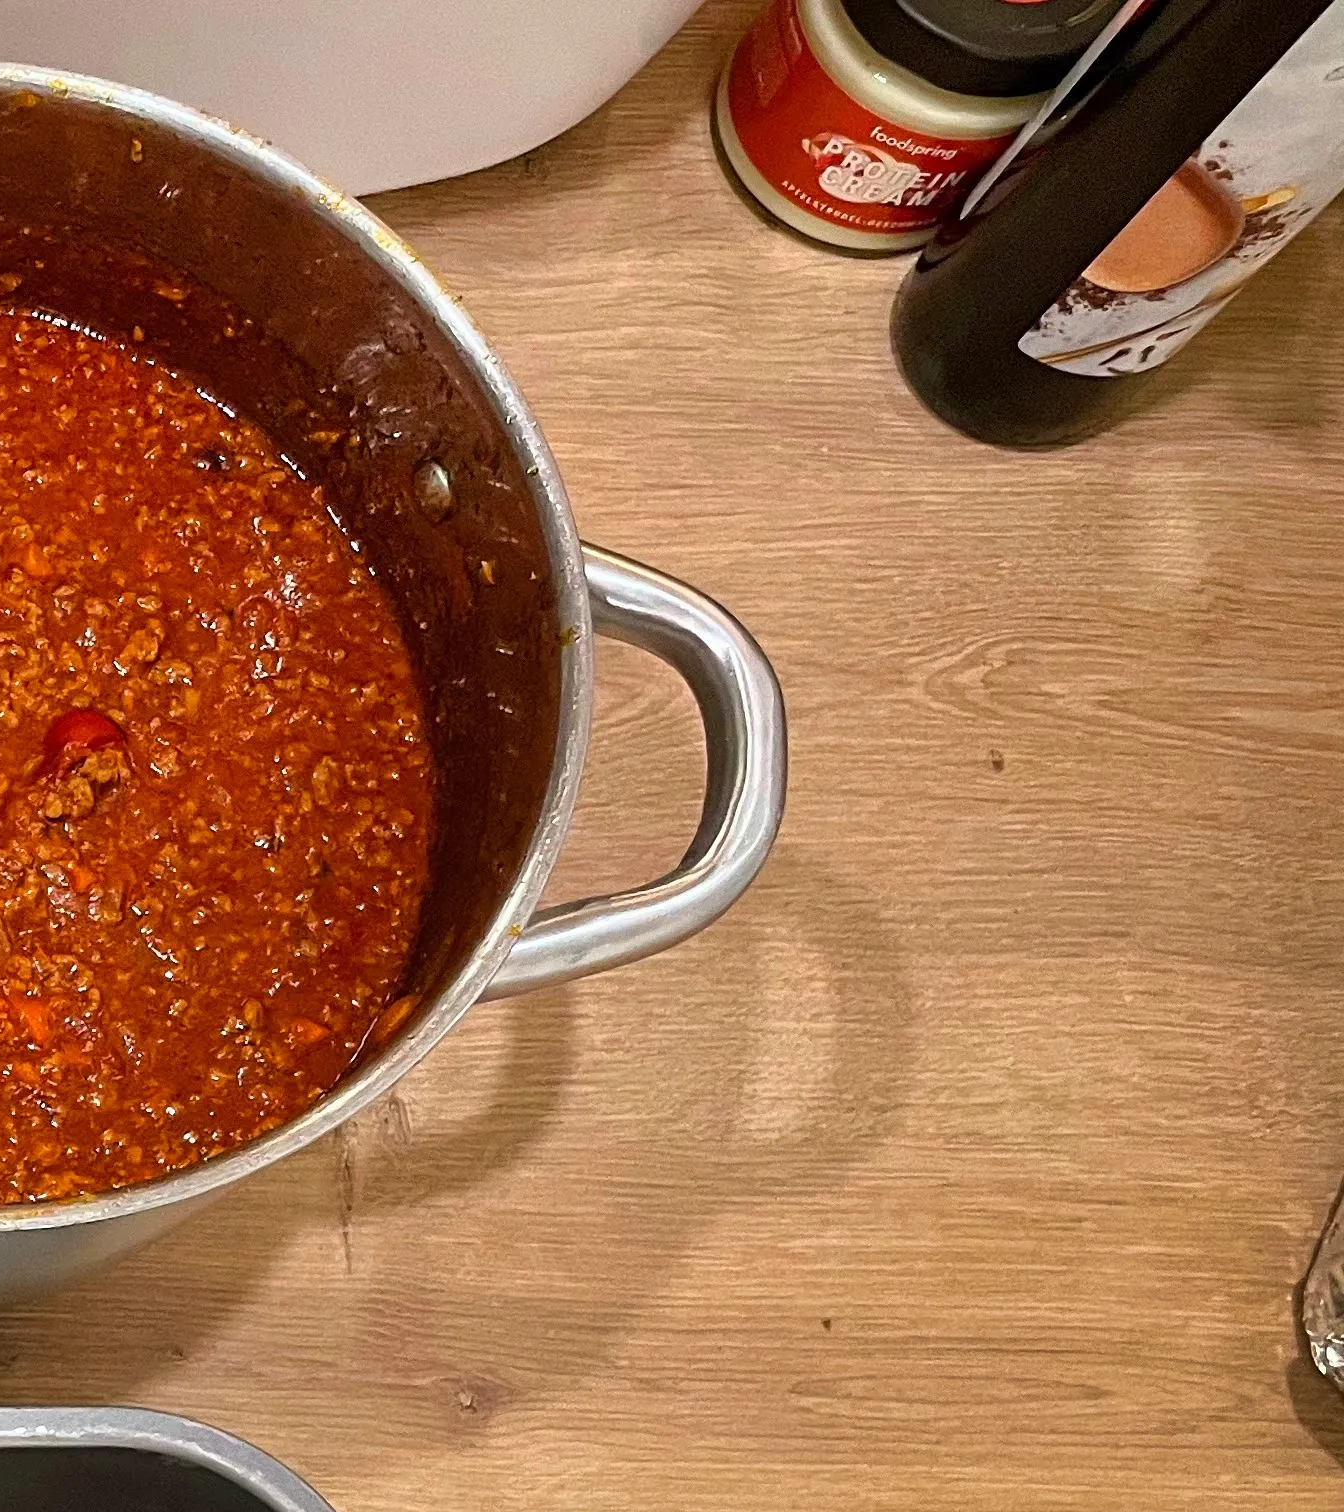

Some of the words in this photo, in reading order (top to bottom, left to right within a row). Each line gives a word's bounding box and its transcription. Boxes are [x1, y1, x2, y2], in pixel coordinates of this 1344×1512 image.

[823, 138, 966, 189] PROTEIN
[869, 126, 958, 161] foodspring
[821, 166, 940, 206] CREAM
